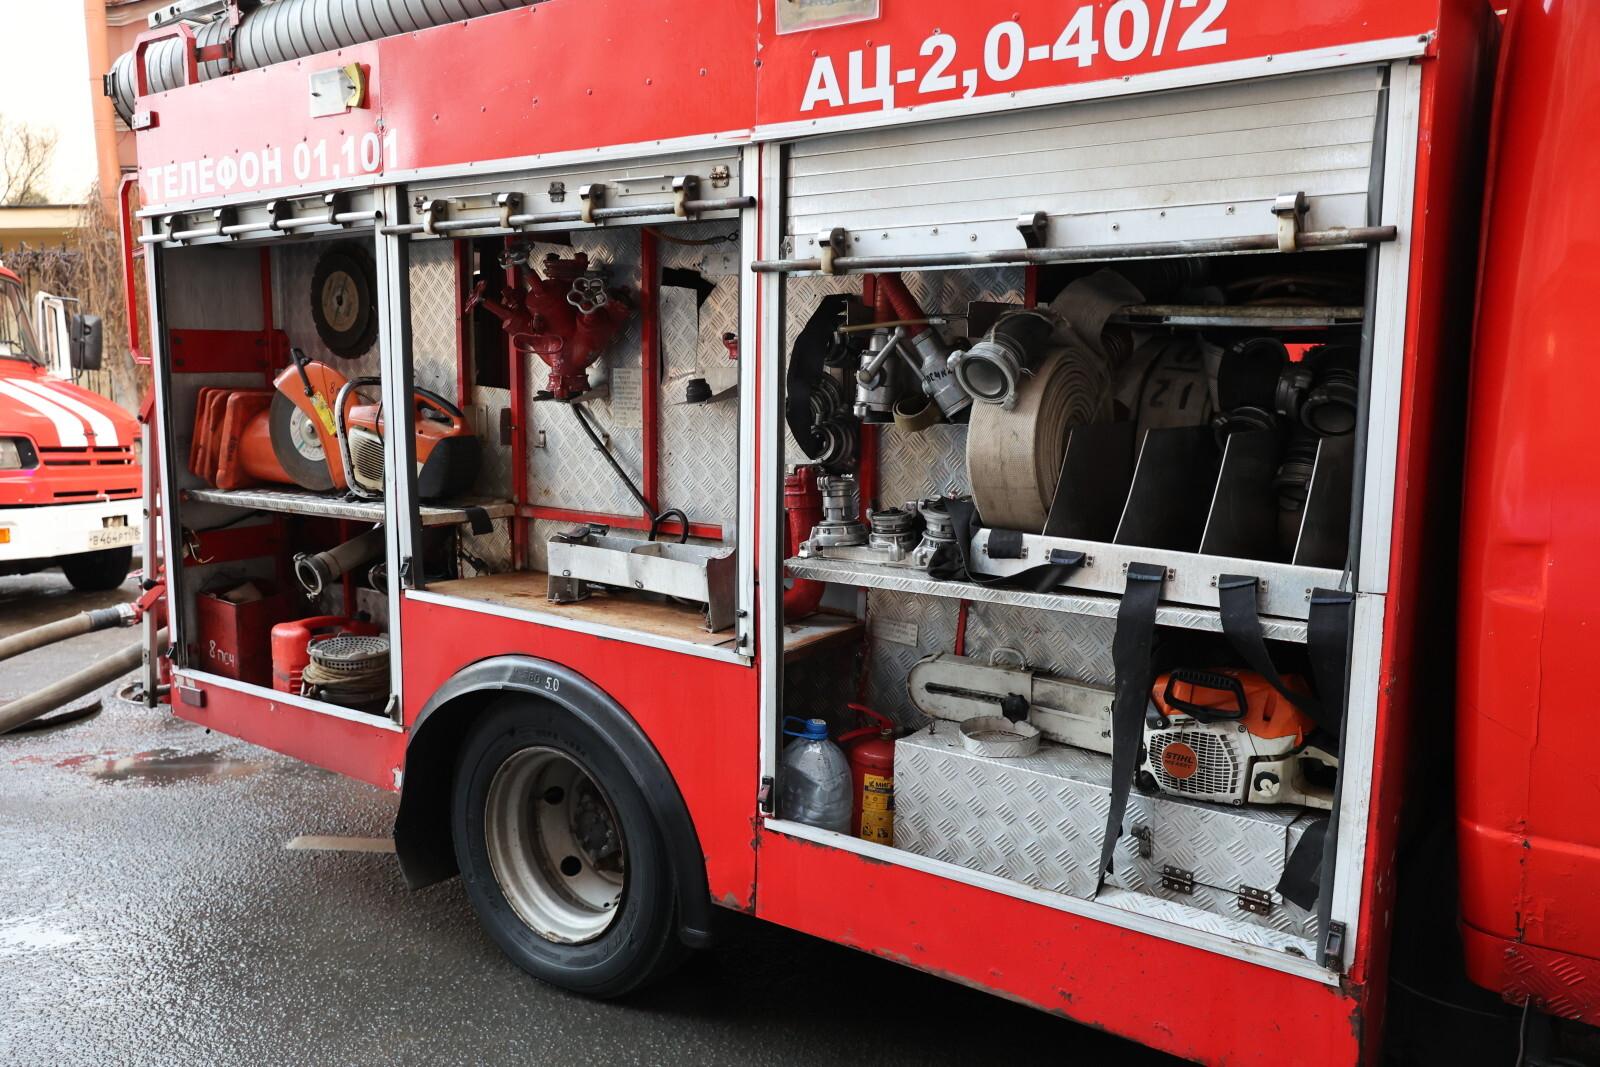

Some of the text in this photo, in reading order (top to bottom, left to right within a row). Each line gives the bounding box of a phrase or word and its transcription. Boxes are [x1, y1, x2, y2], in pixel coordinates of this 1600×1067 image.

[800, 0, 1227, 113] АЦ-2,0-40/2
[147, 128, 398, 200] ТЕЛЕФОН 01,101
[209, 639, 217, 659] 8
[1165, 751, 1194, 765] STIHL
